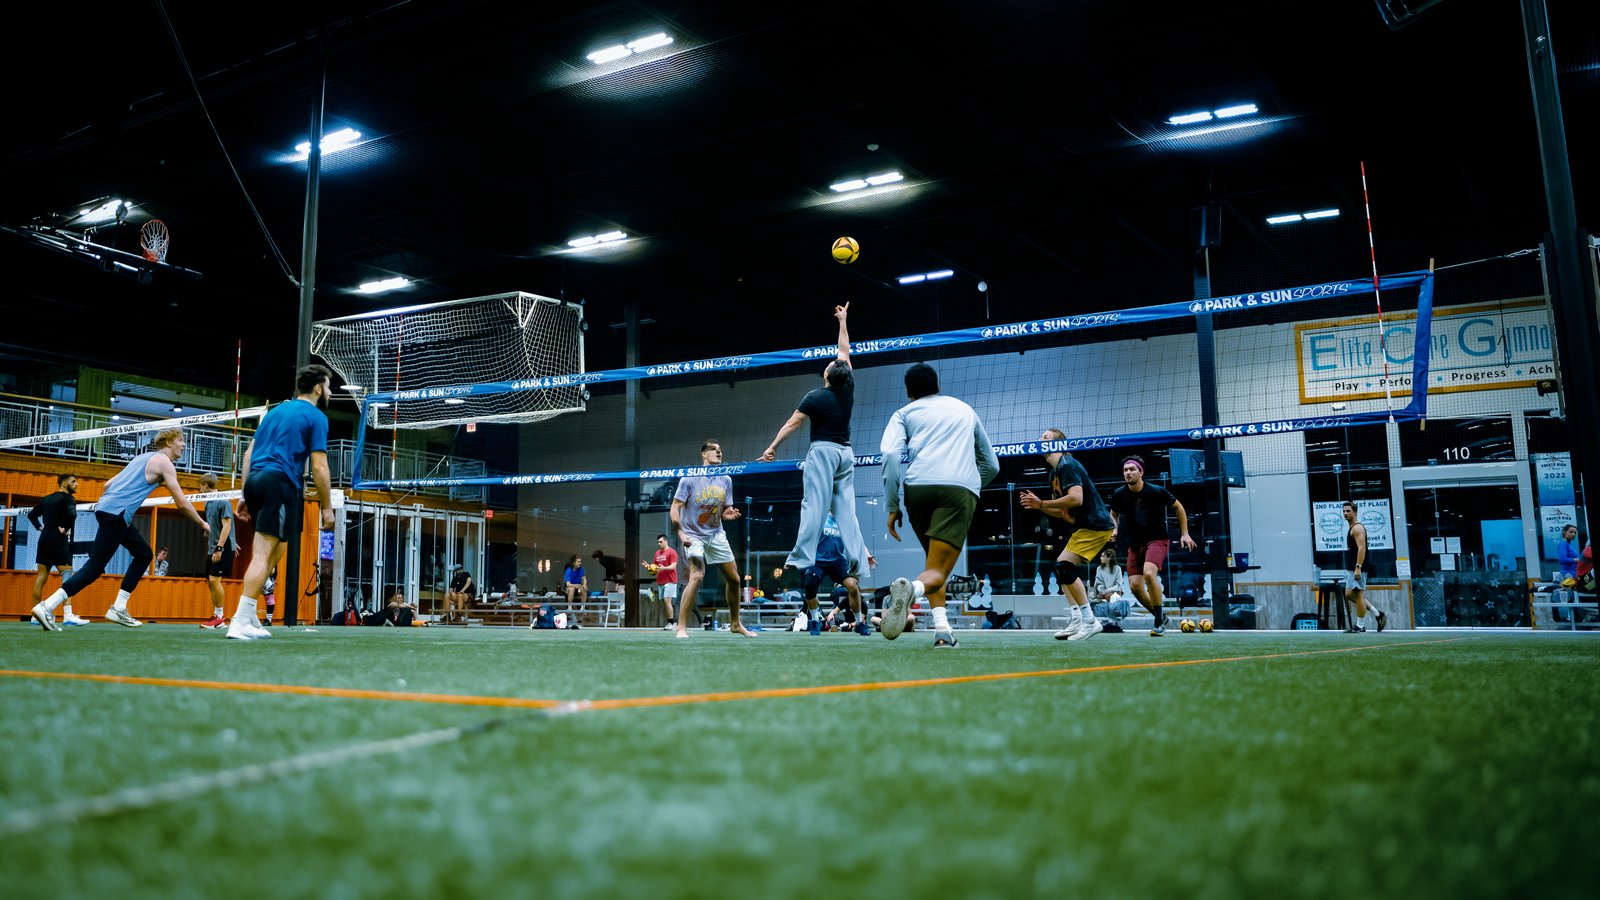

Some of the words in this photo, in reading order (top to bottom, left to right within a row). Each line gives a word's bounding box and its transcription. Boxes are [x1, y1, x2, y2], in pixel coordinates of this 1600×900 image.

[1205, 296, 1243, 311] PARK
[1247, 295, 1257, 306] &
[1262, 290, 1292, 304] SUN
[995, 323, 1028, 336] PARK
[1031, 322, 1040, 333] &
[1043, 318, 1070, 331] SUN
[855, 341, 878, 353] SUN
[1310, 334, 1372, 371] Elite
[1380, 326, 1449, 364] Cre
[1458, 318, 1551, 359] Gymna
[656, 363, 681, 375] PARK
[684, 362, 691, 372] &
[692, 360, 714, 371] SUN
[520, 378, 543, 389] PARK
[544, 377, 550, 387] &
[552, 376, 570, 386] SUN
[1335, 381, 1359, 392] Play
[1380, 377, 1411, 388] Perfo
[1451, 368, 1506, 381] Progress
[1529, 363, 1553, 375] Ach
[400, 390, 419, 399] PARK
[421, 390, 427, 398] &
[428, 388, 444, 397] SUN
[104, 426, 118, 434] PARK
[1204, 426, 1243, 439] PARK
[1247, 424, 1258, 434] &
[1262, 421, 1293, 432] SUN
[992, 444, 1025, 455] PARK
[1028, 443, 1037, 453] &
[1041, 440, 1068, 452] SUN
[1443, 446, 1470, 460] 110
[512, 476, 533, 485] PARK
[535, 475, 542, 484] &
[544, 474, 561, 483] SUN
[650, 469, 675, 478] PARK
[677, 468, 684, 477] &
[687, 467, 707, 476] SUN
